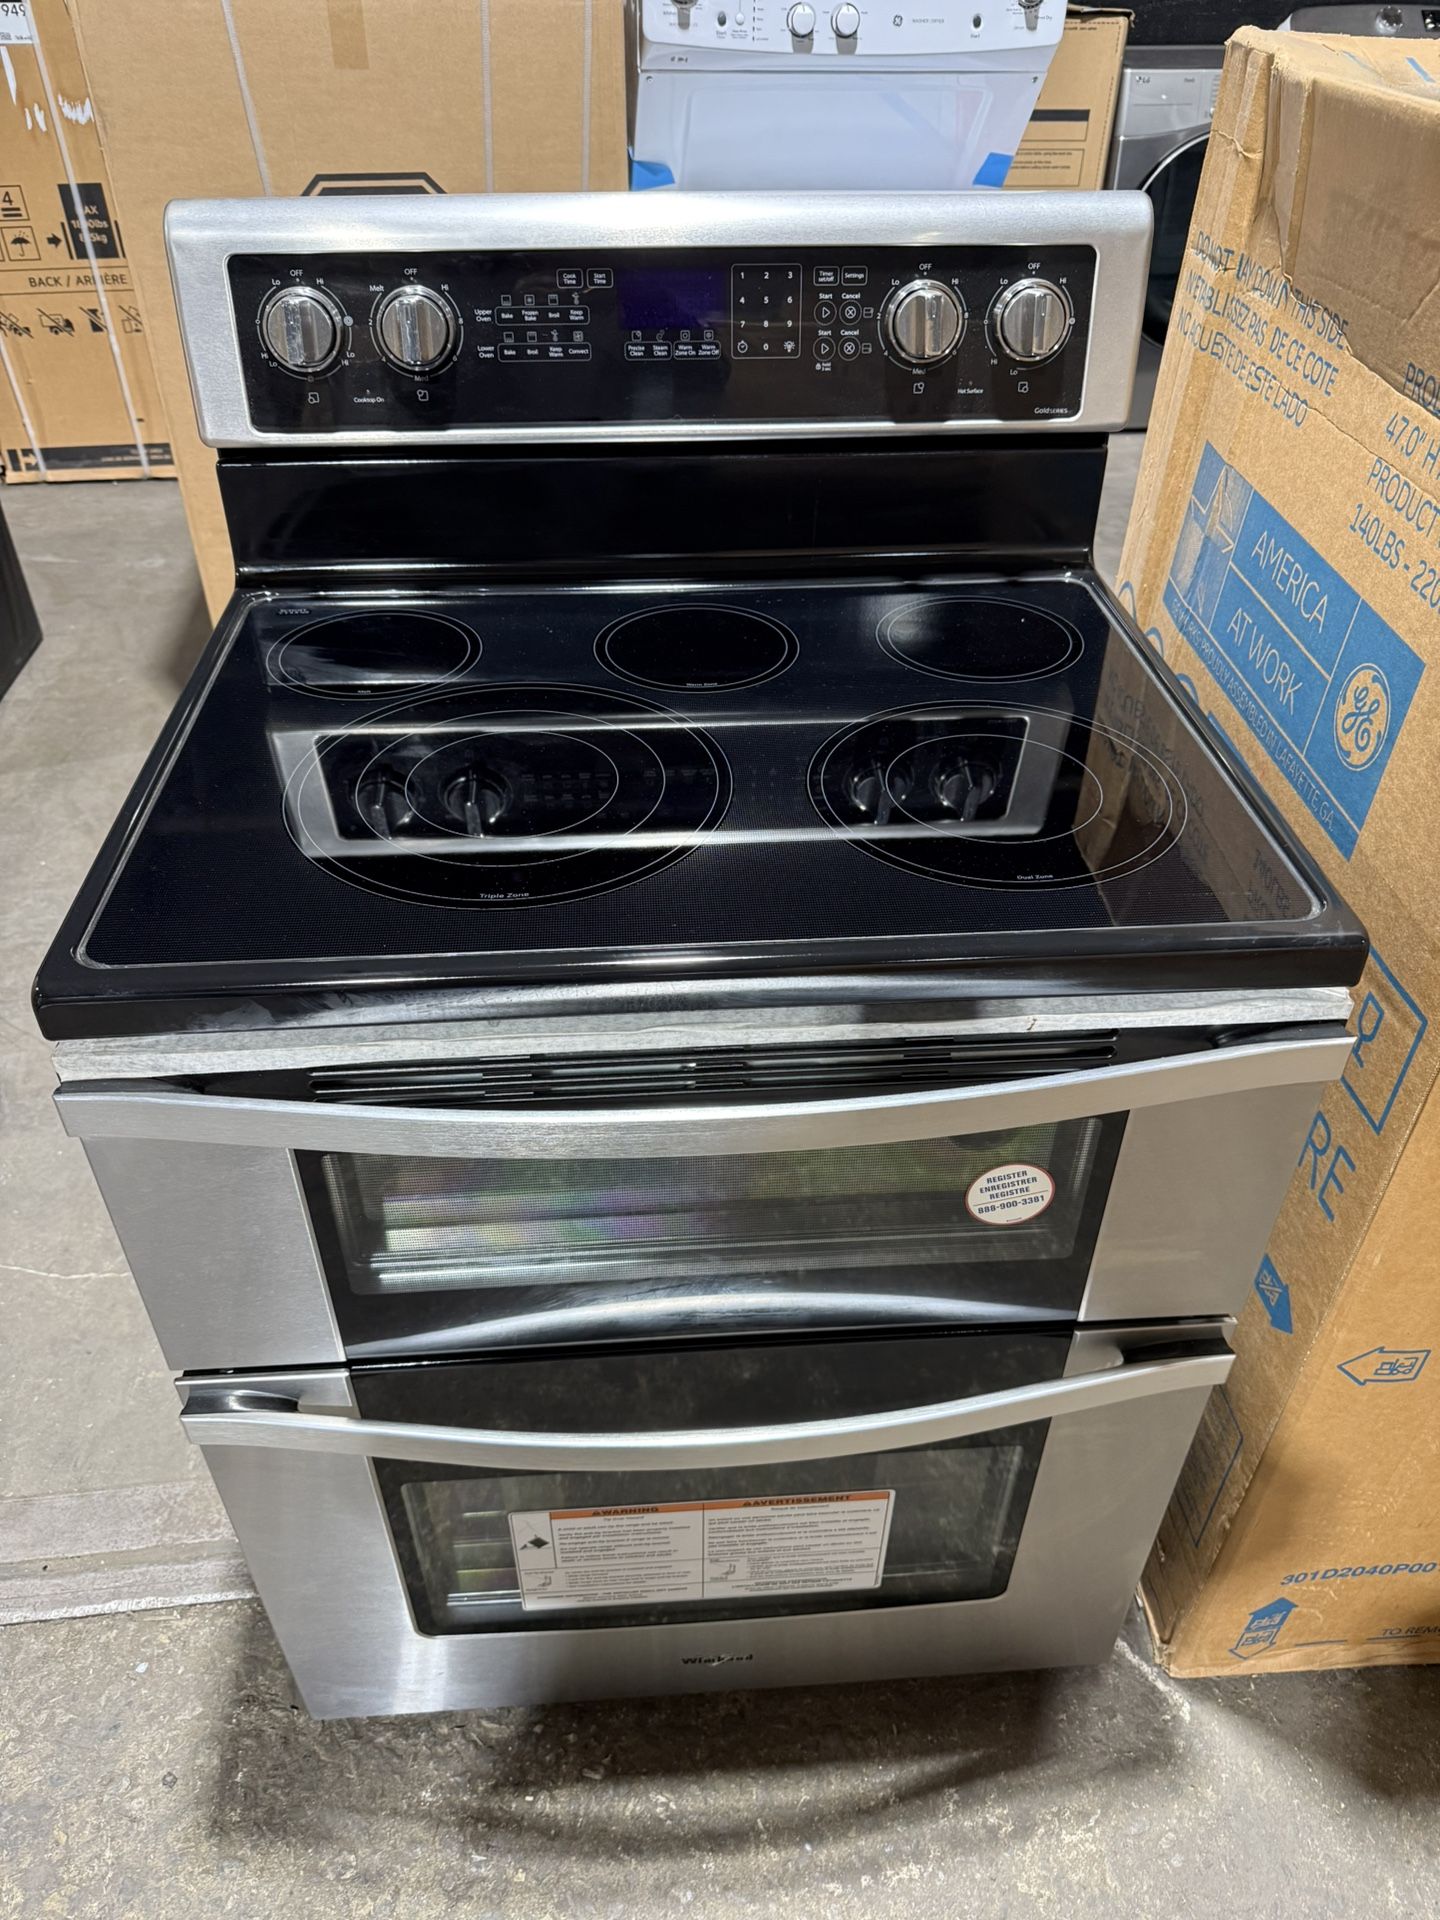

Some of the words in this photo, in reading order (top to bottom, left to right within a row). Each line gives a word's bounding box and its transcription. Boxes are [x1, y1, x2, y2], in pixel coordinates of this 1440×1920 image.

[2, 191, 14, 205] 4
[28, 276, 62, 287] BACK
[76, 272, 128, 286] ARIÈRE
[1269, 326, 1289, 360] DE
[1286, 339, 1306, 372] CE
[1302, 351, 1339, 397] COTE
[1403, 362, 1440, 414] PRO
[1366, 456, 1440, 538] PRODUCT
[1349, 503, 1405, 570] 140LBS
[1251, 530, 1329, 634] AMERICA
[1227, 607, 1252, 647] AT
[1249, 626, 1303, 716] WORK
[979, 1177, 1038, 1194] ENREGISTRER
[986, 1170, 1028, 1184] REGISTER
[989, 1186, 1031, 1200] REGISTRE
[977, 1195, 1045, 1214] 888-900-3381
[752, 1495, 850, 1507] AVERTISSEMENT
[602, 1507, 659, 1516] WARNING
[1280, 1561, 1440, 1585] 301D2040P00
